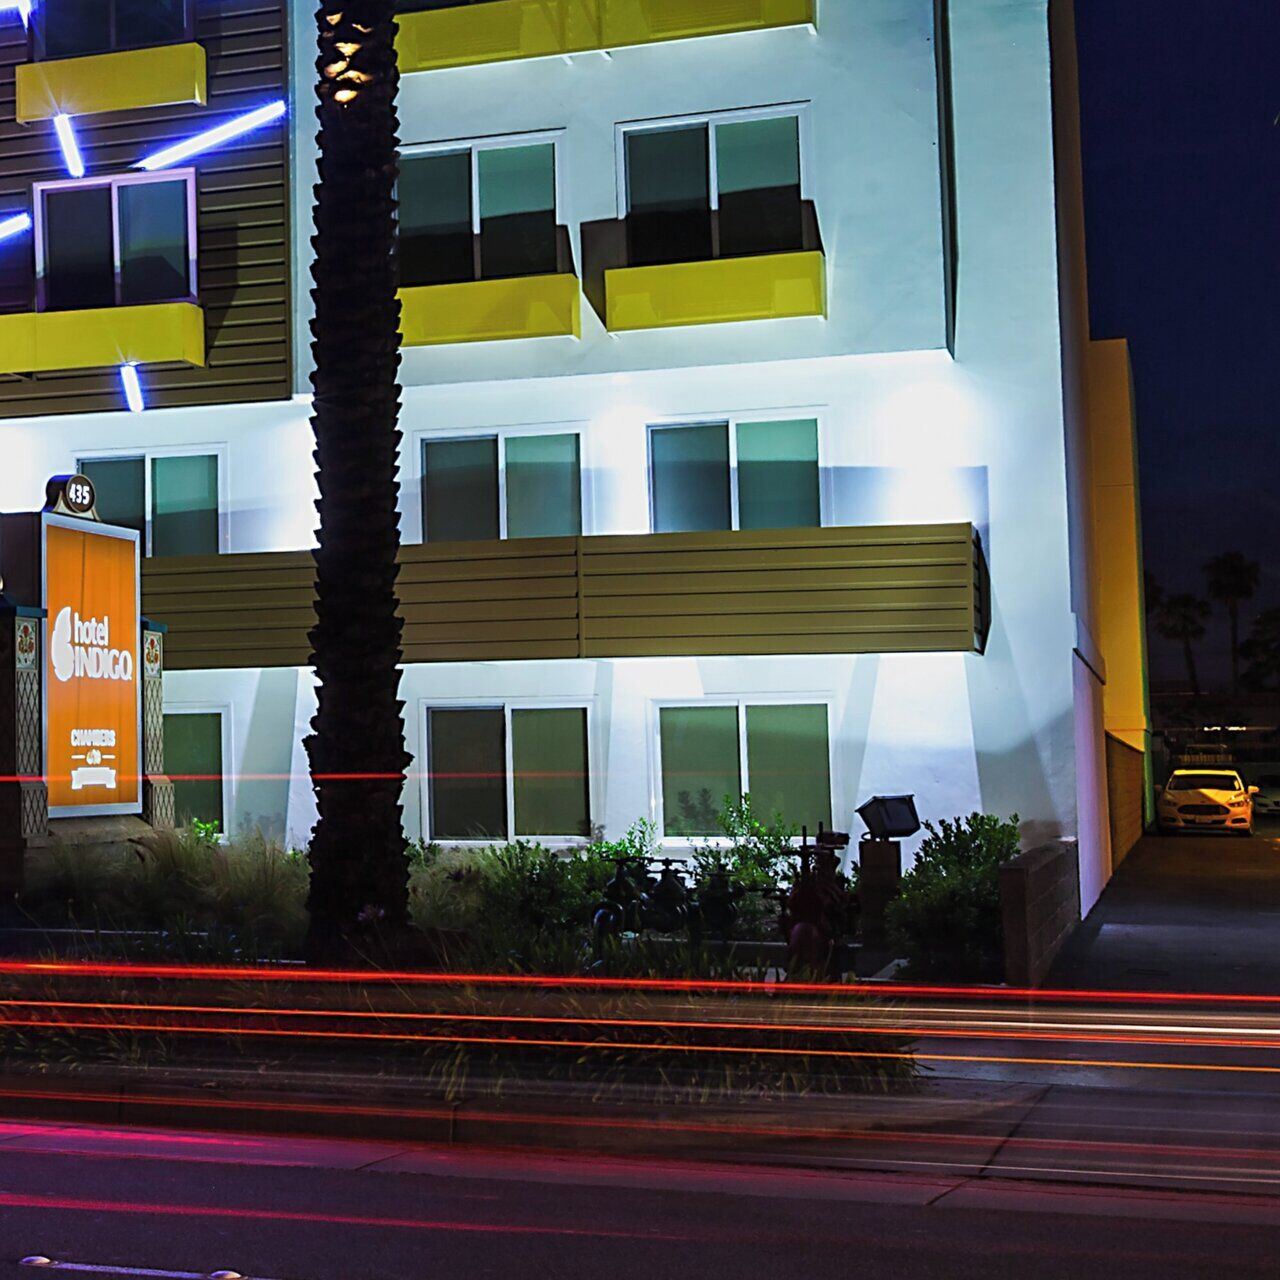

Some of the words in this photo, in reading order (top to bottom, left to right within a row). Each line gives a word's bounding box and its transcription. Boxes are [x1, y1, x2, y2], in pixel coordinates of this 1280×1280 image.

[69, 483, 90, 505] 435
[74, 612, 109, 646] hotel
[74, 646, 133, 681] INDIGO
